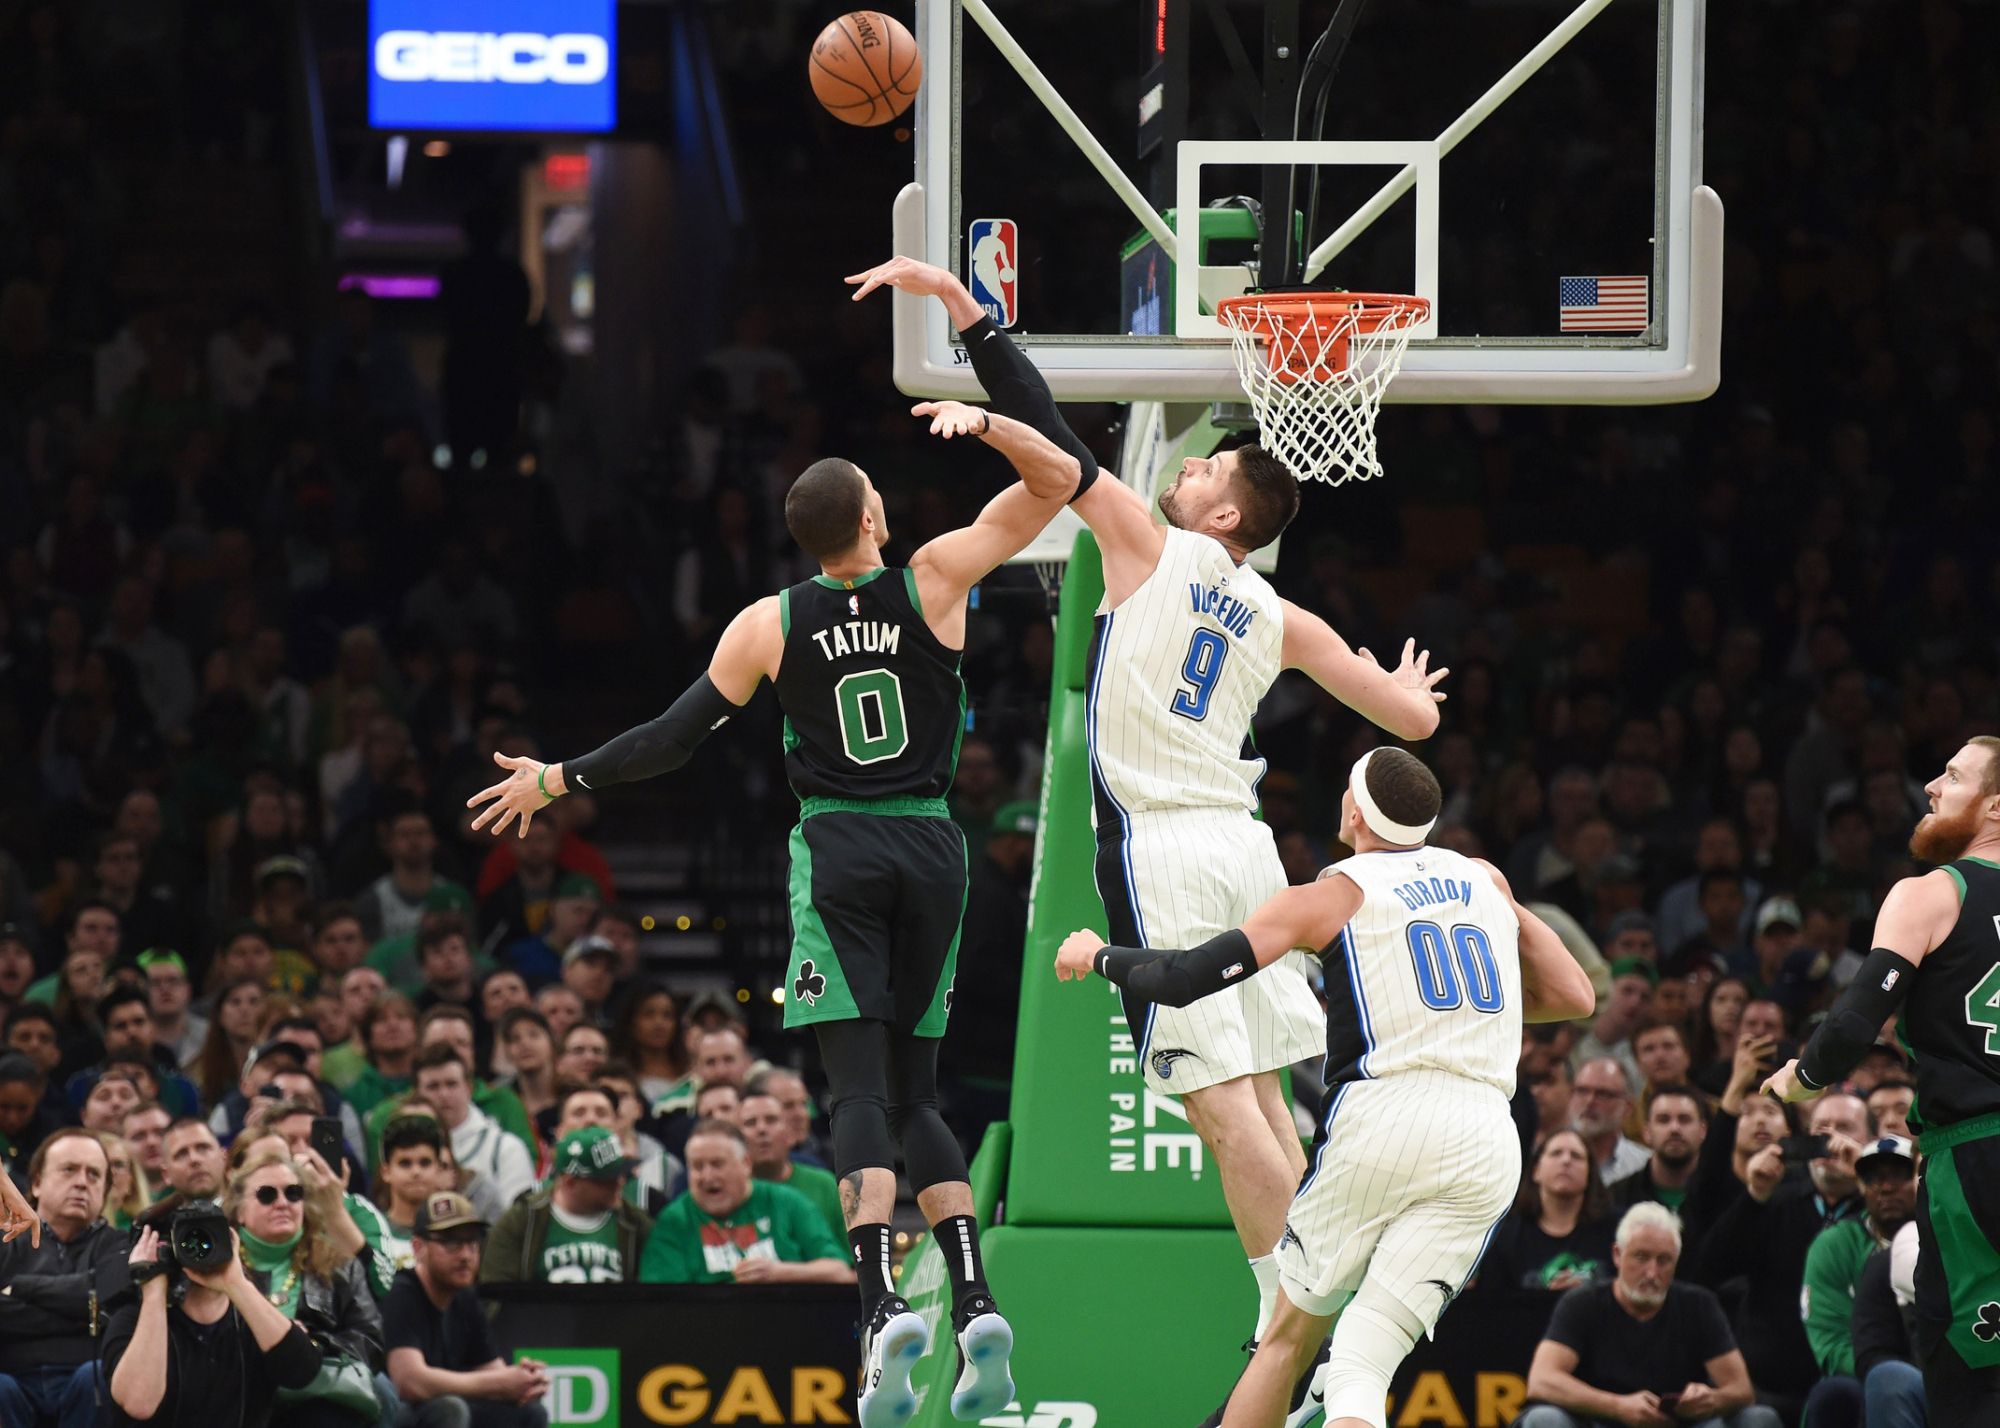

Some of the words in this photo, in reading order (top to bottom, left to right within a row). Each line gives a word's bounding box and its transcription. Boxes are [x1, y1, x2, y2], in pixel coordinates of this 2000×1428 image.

[375, 30, 609, 84] GEICO
[811, 621, 900, 661] TATUM
[1169, 627, 1229, 722] 9
[834, 667, 909, 766] 0
[1393, 877, 1472, 911] GORDON
[1405, 920, 1505, 1014] 00
[1110, 1093, 1136, 1172] PAIN
[637, 1363, 859, 1426] GAR
